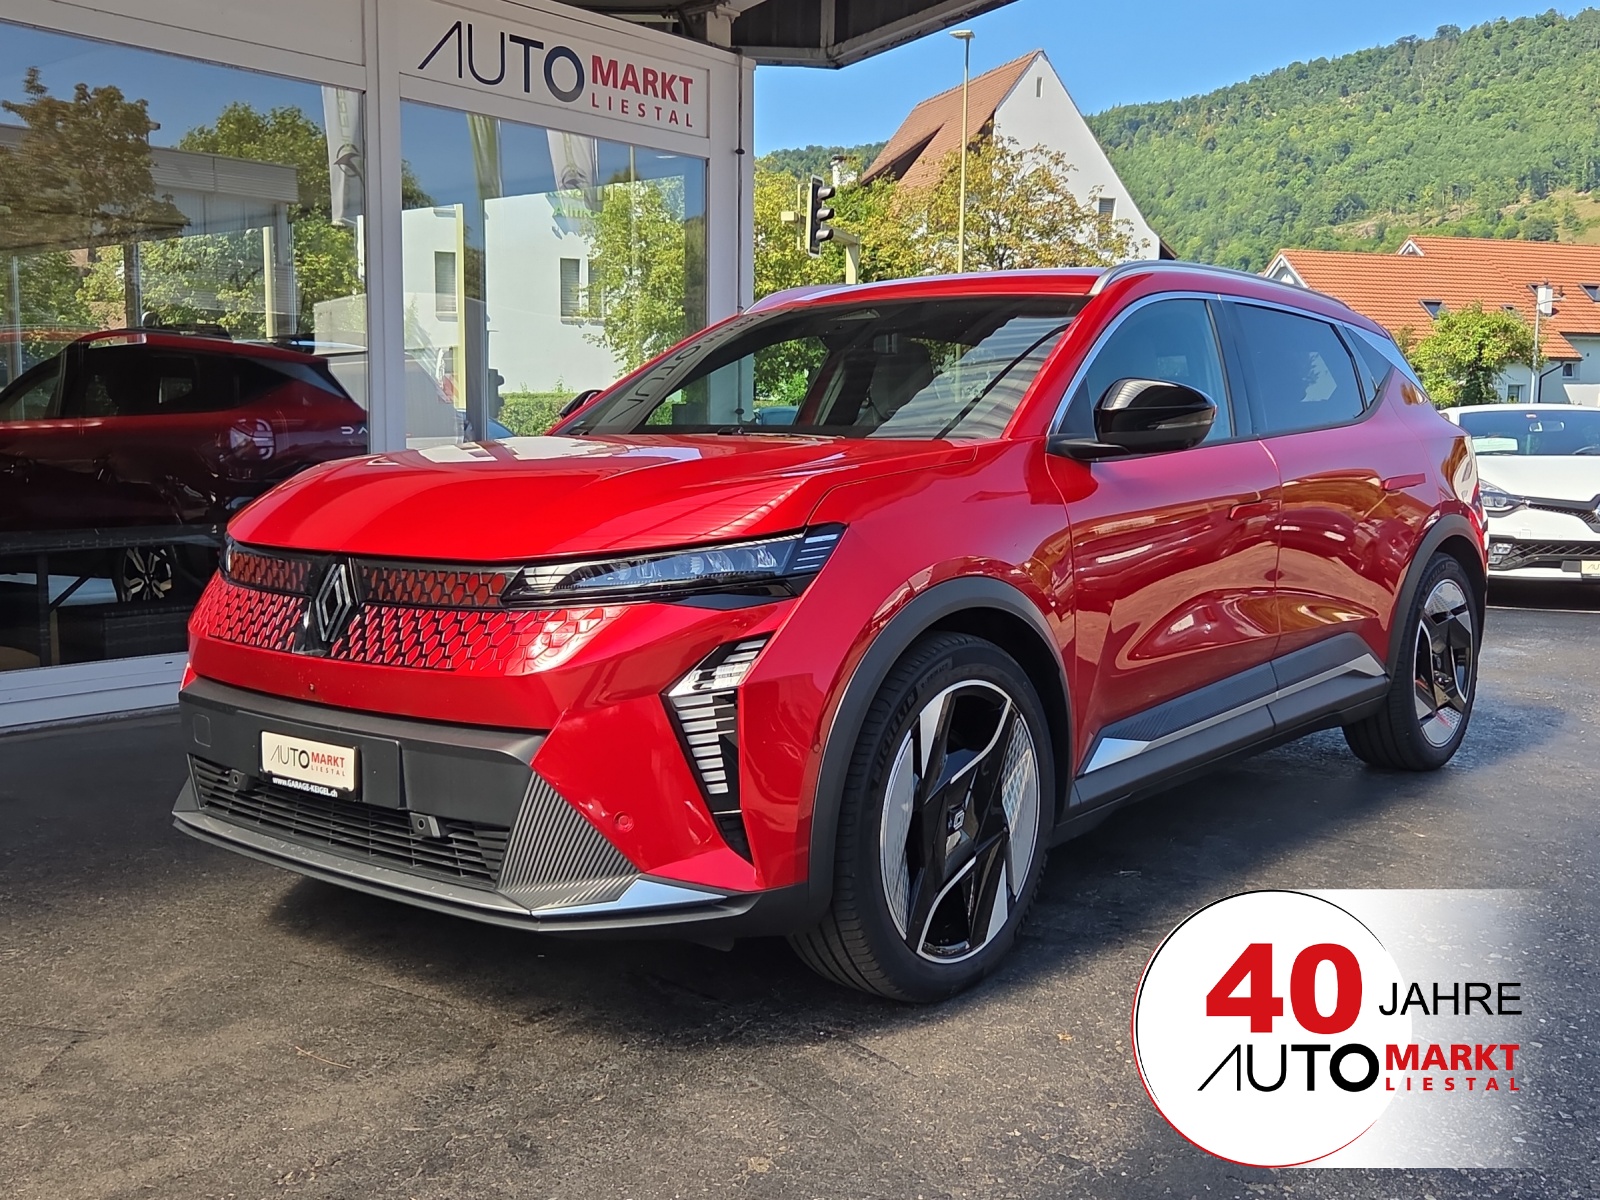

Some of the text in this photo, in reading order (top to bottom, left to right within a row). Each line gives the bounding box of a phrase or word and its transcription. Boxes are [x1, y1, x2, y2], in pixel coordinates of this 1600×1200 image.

[417, 20, 693, 105] AUTO MARKT
[591, 92, 693, 128] LIESTAL
[872, 691, 916, 784] MICHELIN
[270, 744, 346, 769] AUTO MARKT
[310, 764, 346, 777] LIESTAL
